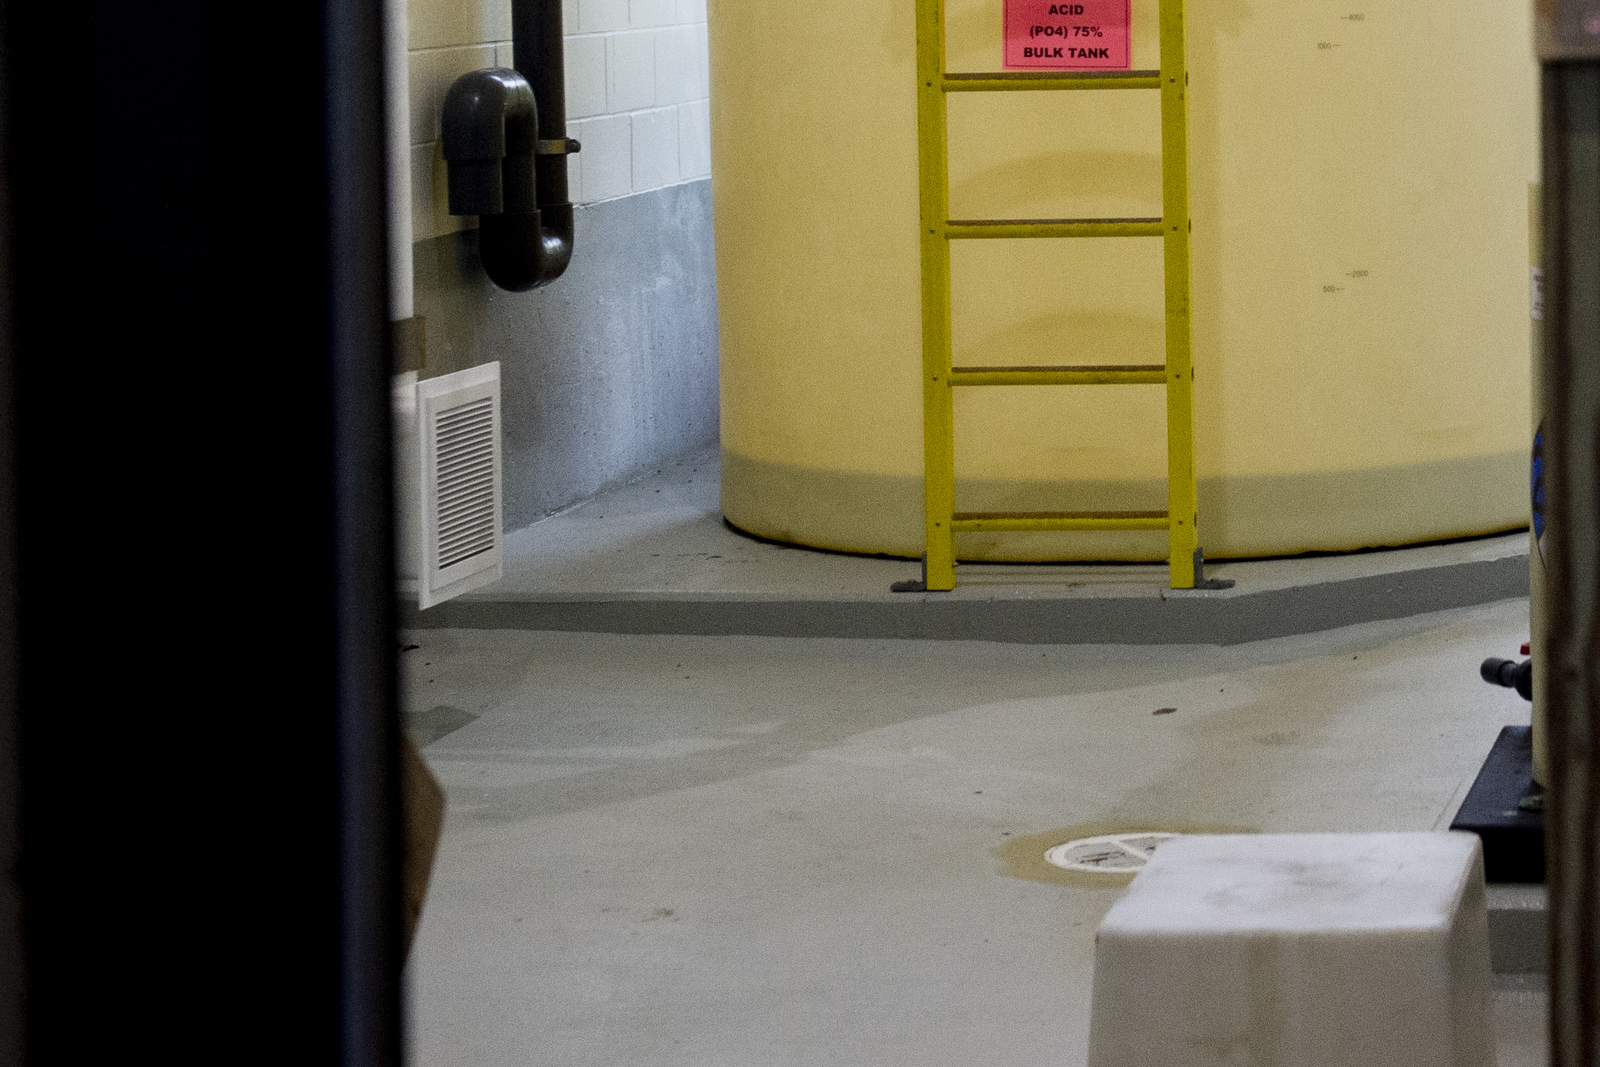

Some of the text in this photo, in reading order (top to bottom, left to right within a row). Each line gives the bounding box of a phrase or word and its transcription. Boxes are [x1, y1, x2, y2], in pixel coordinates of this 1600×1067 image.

[1048, 4, 1084, 15] ACID
[1029, 25, 1103, 39] (PO4) 75%
[1023, 47, 1109, 59] BULK TANK
